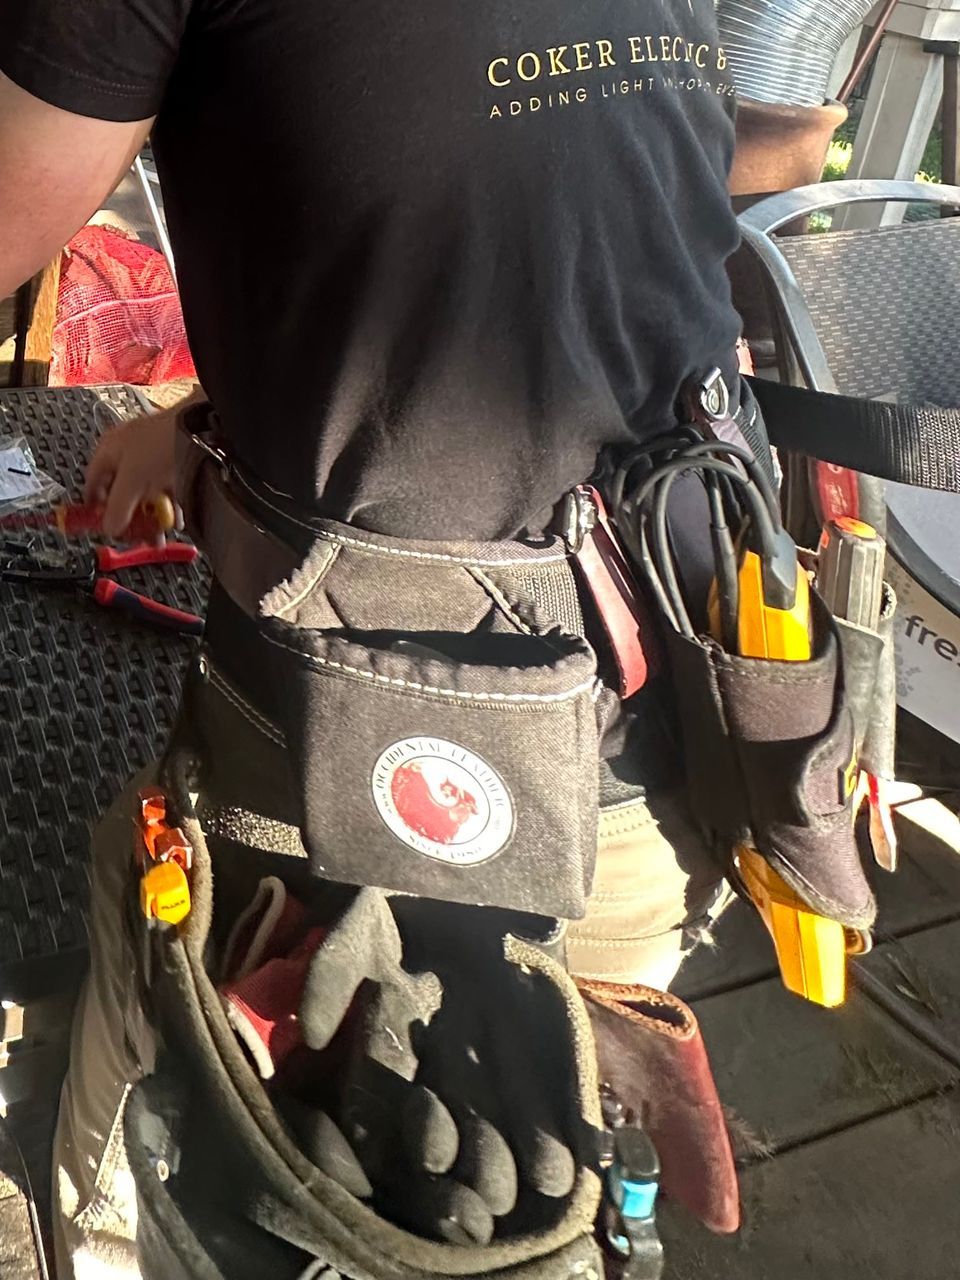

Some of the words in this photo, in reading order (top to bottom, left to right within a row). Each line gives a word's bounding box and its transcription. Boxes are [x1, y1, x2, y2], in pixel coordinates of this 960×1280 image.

[487, 39, 617, 87] COKER
[489, 88, 588, 119] ADDING
[601, 78, 654, 98] LIGHT
[903, 614, 960, 668] fre
